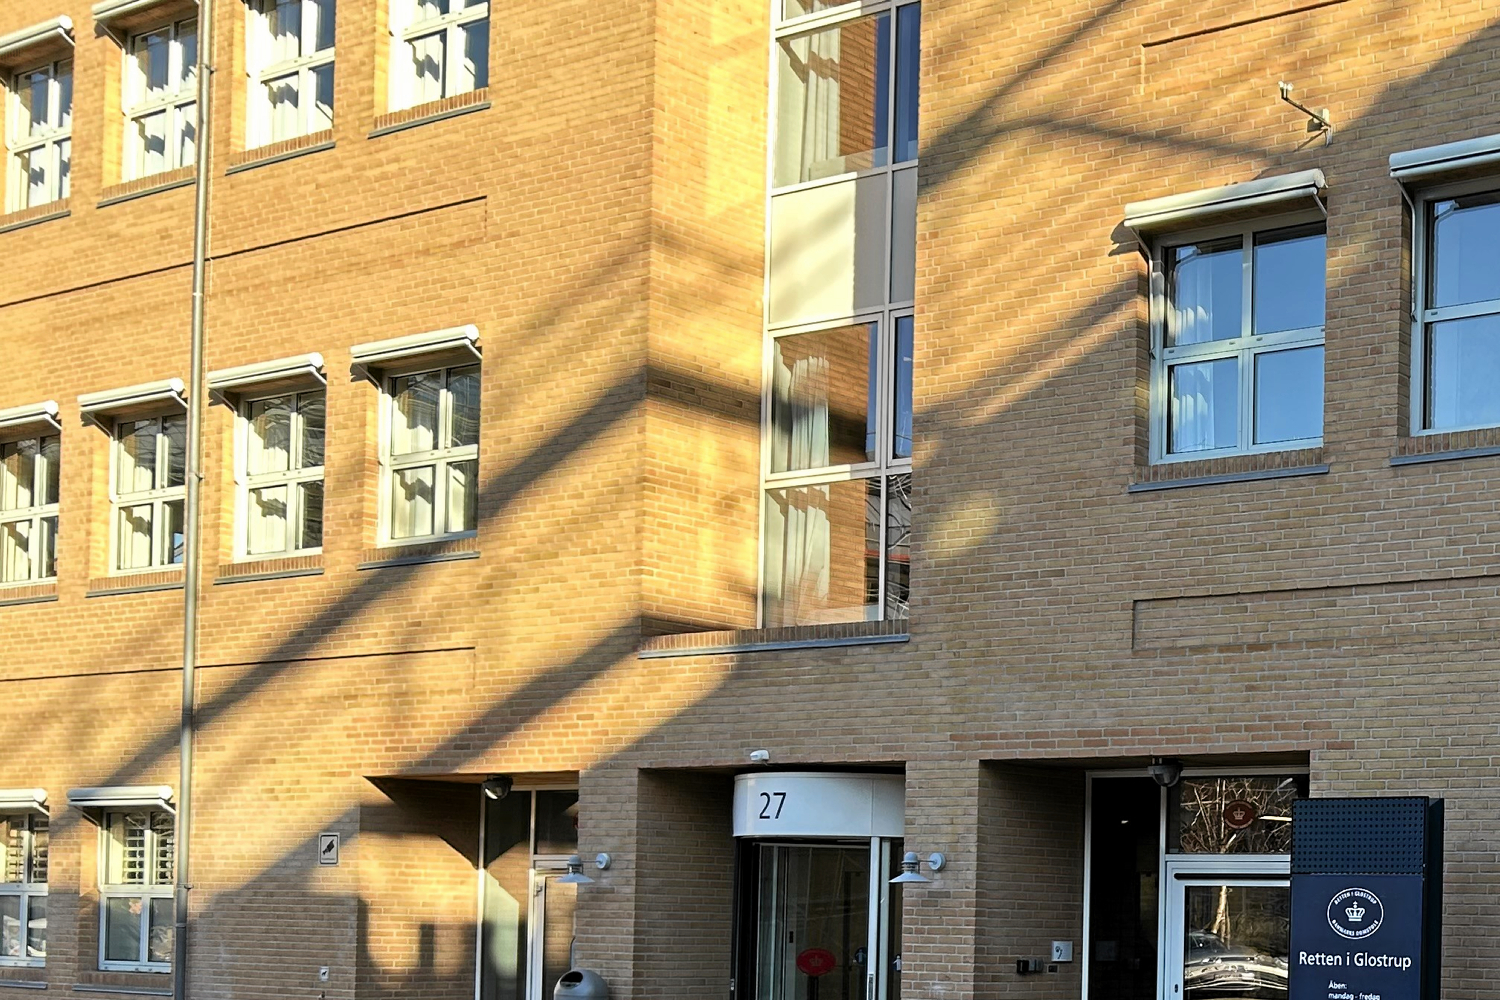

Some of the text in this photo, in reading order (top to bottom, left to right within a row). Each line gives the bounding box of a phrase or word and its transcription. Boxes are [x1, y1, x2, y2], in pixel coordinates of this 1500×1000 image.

[759, 792, 787, 820] 27
[1299, 951, 1412, 971] Retten i Glostrup
[1328, 980, 1348, 989] Åben:
